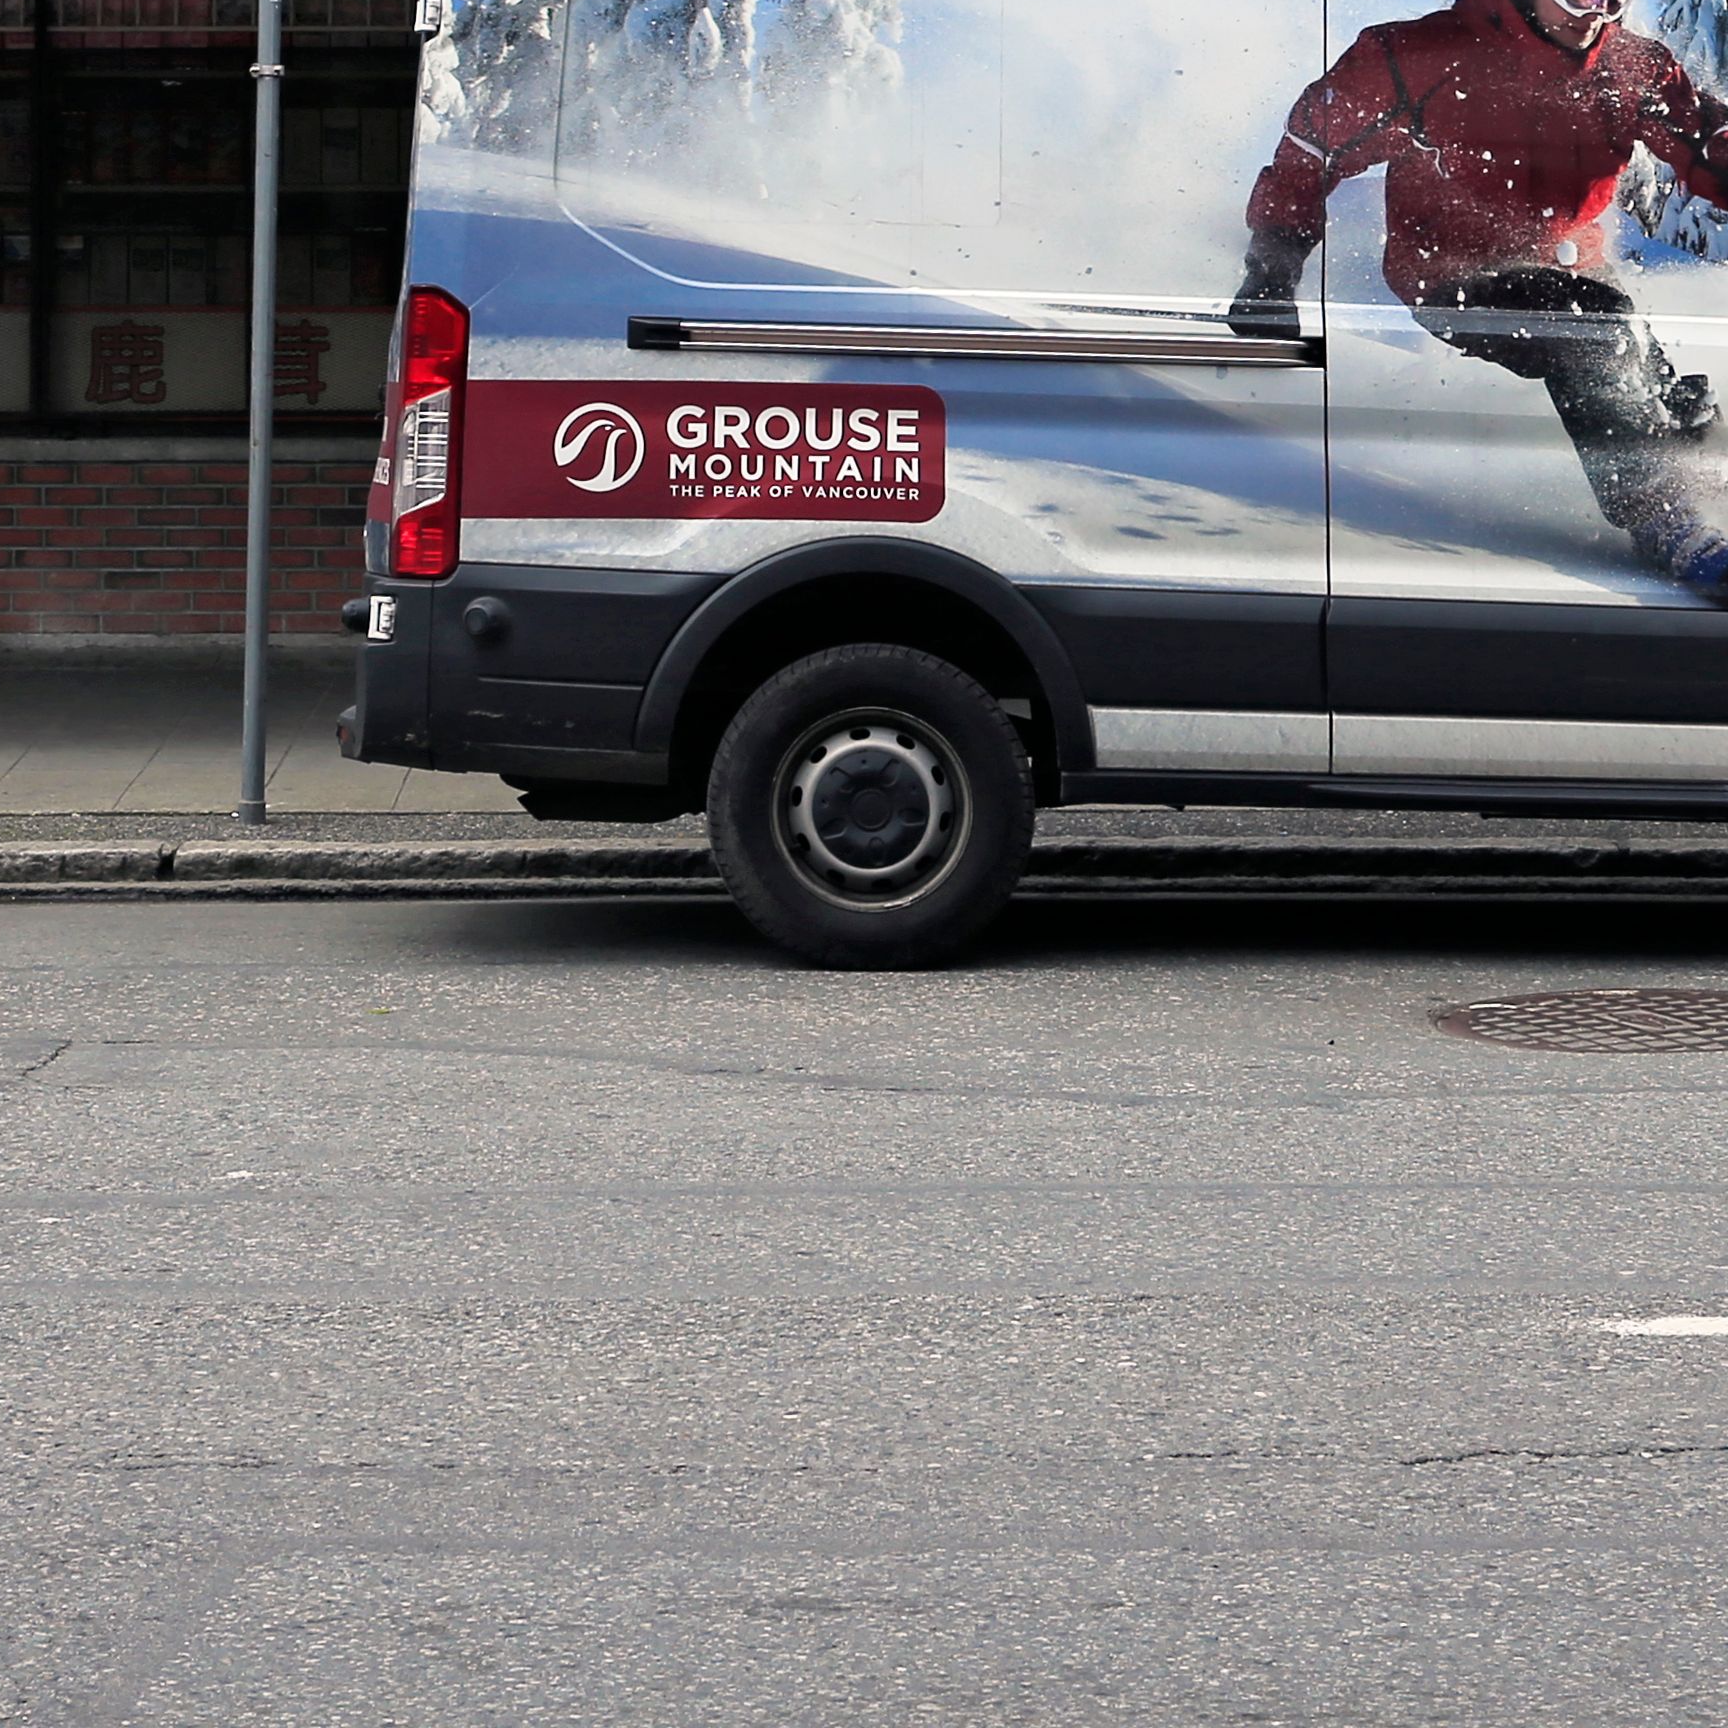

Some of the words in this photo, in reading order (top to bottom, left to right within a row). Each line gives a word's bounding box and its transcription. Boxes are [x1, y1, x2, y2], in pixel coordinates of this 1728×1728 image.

[666, 404, 920, 452] GROUSE
[668, 453, 920, 484] MOUNTAIN
[670, 485, 705, 498] THE
[713, 485, 762, 498] PEAK
[769, 485, 795, 498] OF
[802, 485, 920, 501] VANCOUVER
